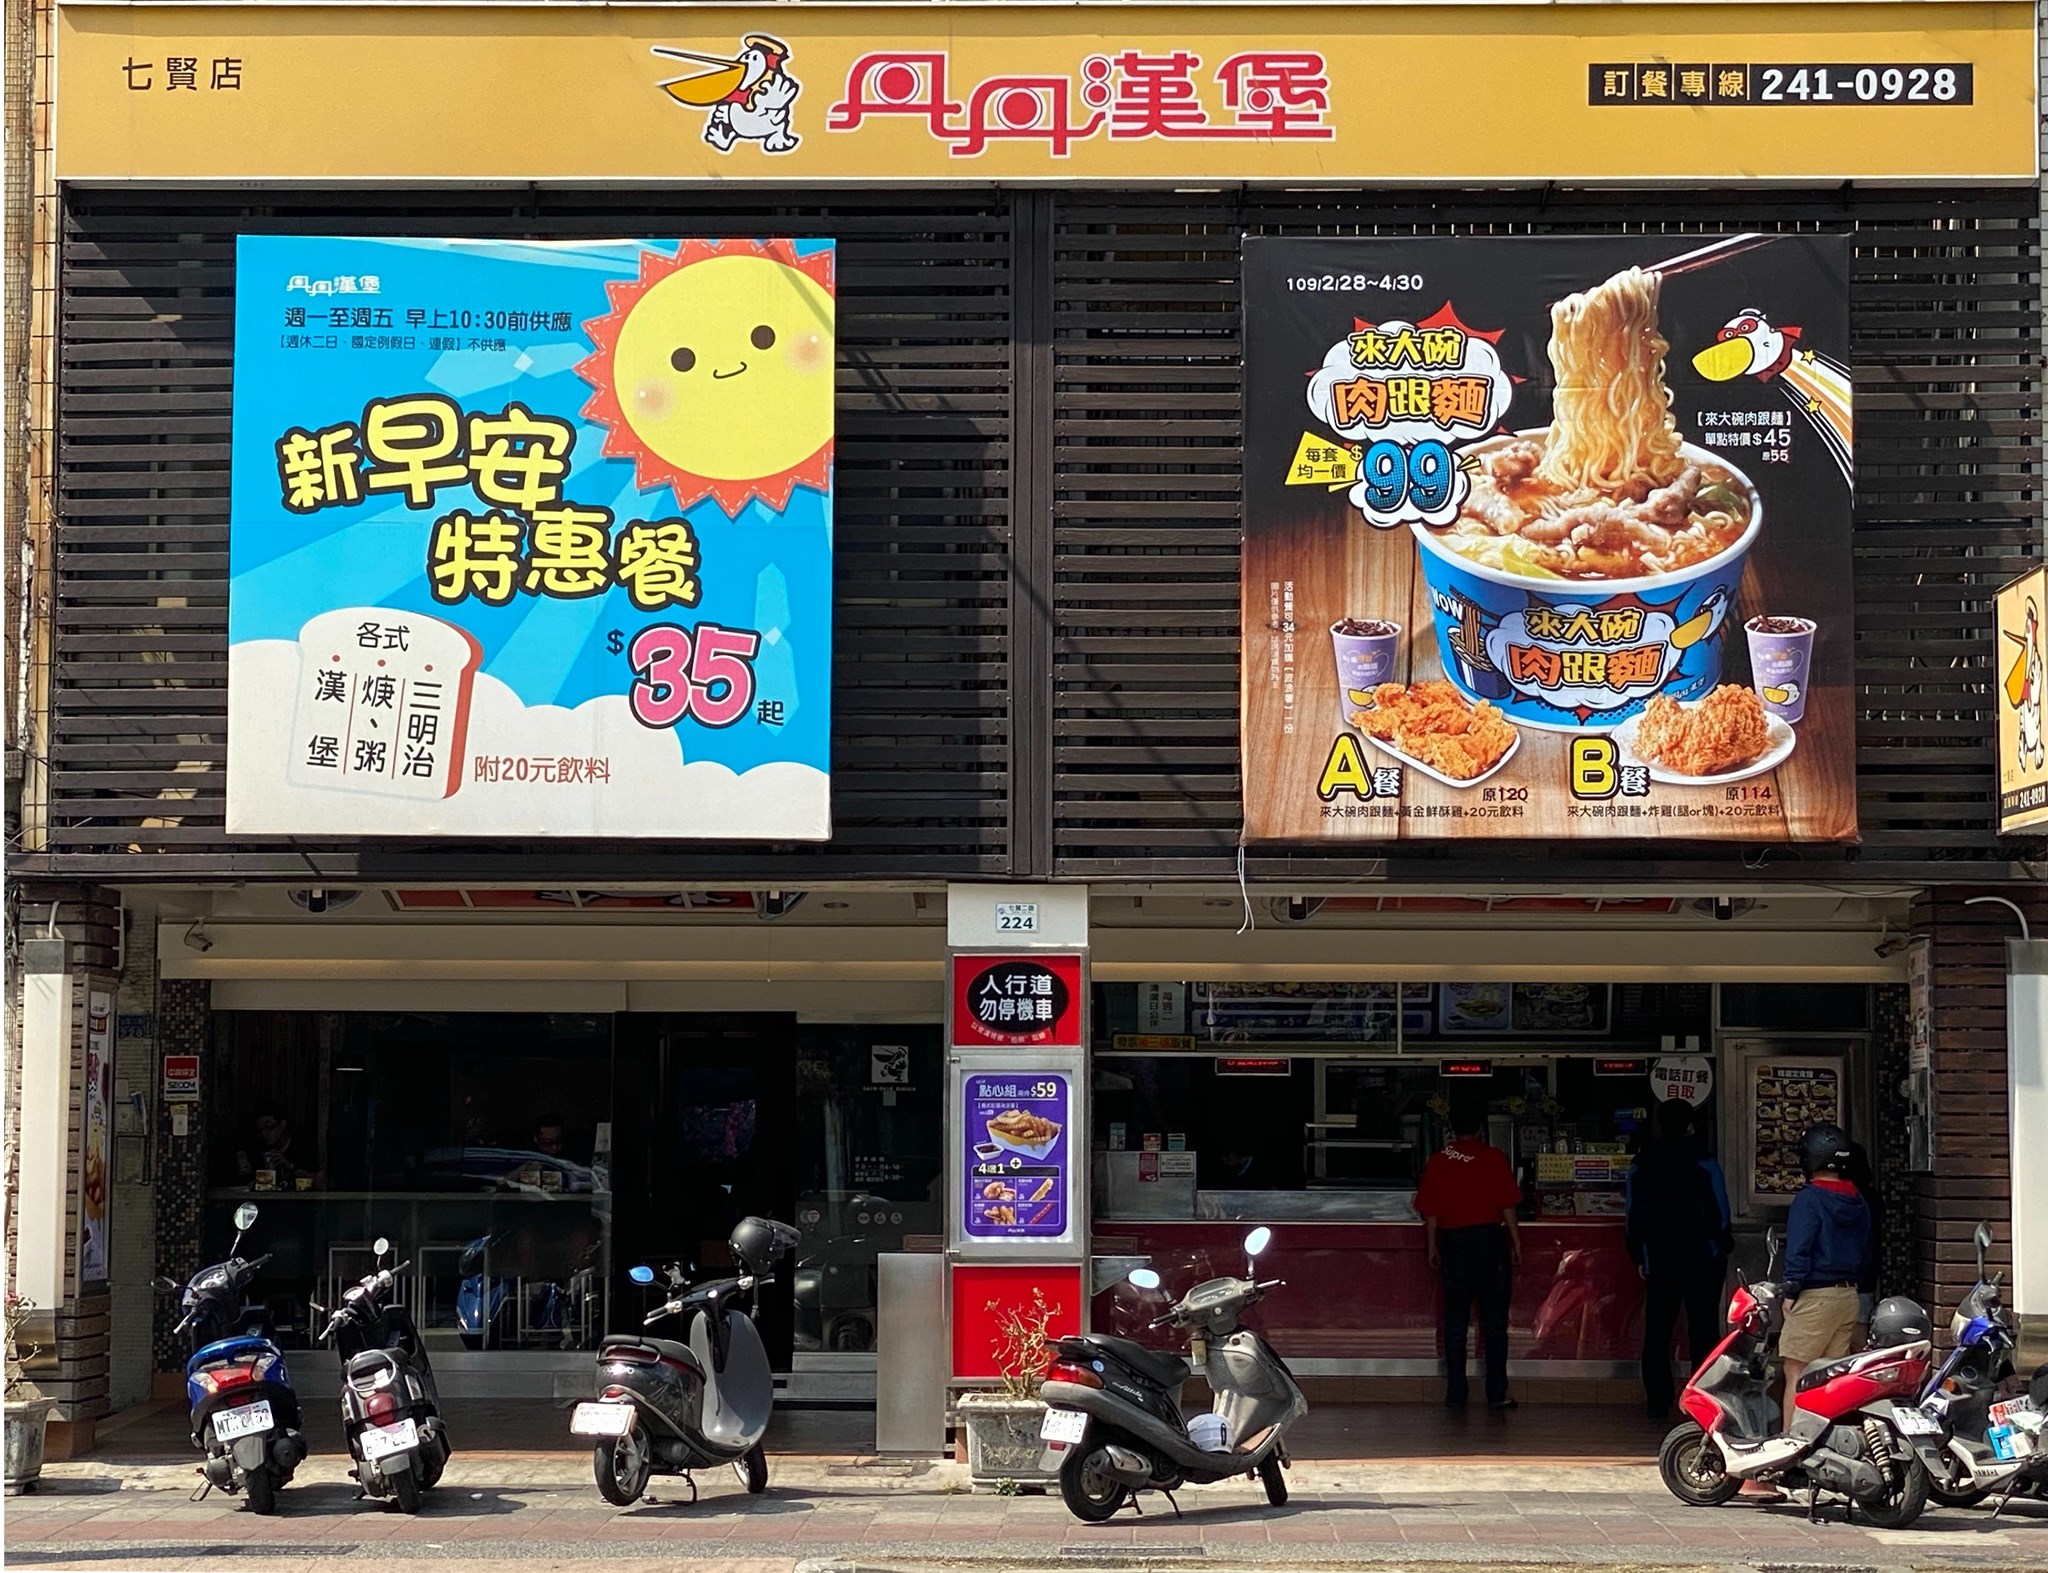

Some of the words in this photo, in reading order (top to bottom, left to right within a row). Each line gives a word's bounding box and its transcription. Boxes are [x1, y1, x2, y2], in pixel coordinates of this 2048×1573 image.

[121, 56, 243, 92] 七賢店
[1603, 69, 1745, 98] 訂餐專線
[1760, 68, 1957, 101] 241-0928
[827, 50, 1336, 158] 丹丹漢堡
[286, 275, 382, 297] 丹丹漢堡
[1286, 273, 1424, 292] 109/2/28~4/30
[284, 306, 394, 329] 週一至週五
[405, 308, 573, 333] 早上10:30前供應
[1349, 328, 1464, 367] 來大碗
[1333, 376, 1491, 427] 肉跟麵
[277, 394, 575, 513] 新早安
[1305, 446, 1339, 463] 每套
[1296, 464, 1347, 479] 均一價
[430, 506, 700, 610] 特惠餐
[355, 621, 410, 653] 各式
[1525, 609, 1643, 643] 來大碗
[1509, 643, 1665, 690] 肉跟麵
[306, 668, 348, 770] 漢堡
[401, 679, 443, 779] 三明治
[473, 754, 611, 786] 附20元飲料
[1000, 916, 1034, 929] 224
[979, 974, 1053, 996] 人行道
[979, 997, 1053, 1021] 勿停機車
[1030, 1081, 1056, 1098] $59
[1655, 1067, 1709, 1084] 電話訂餐
[1667, 1084, 1695, 1100] 自取
